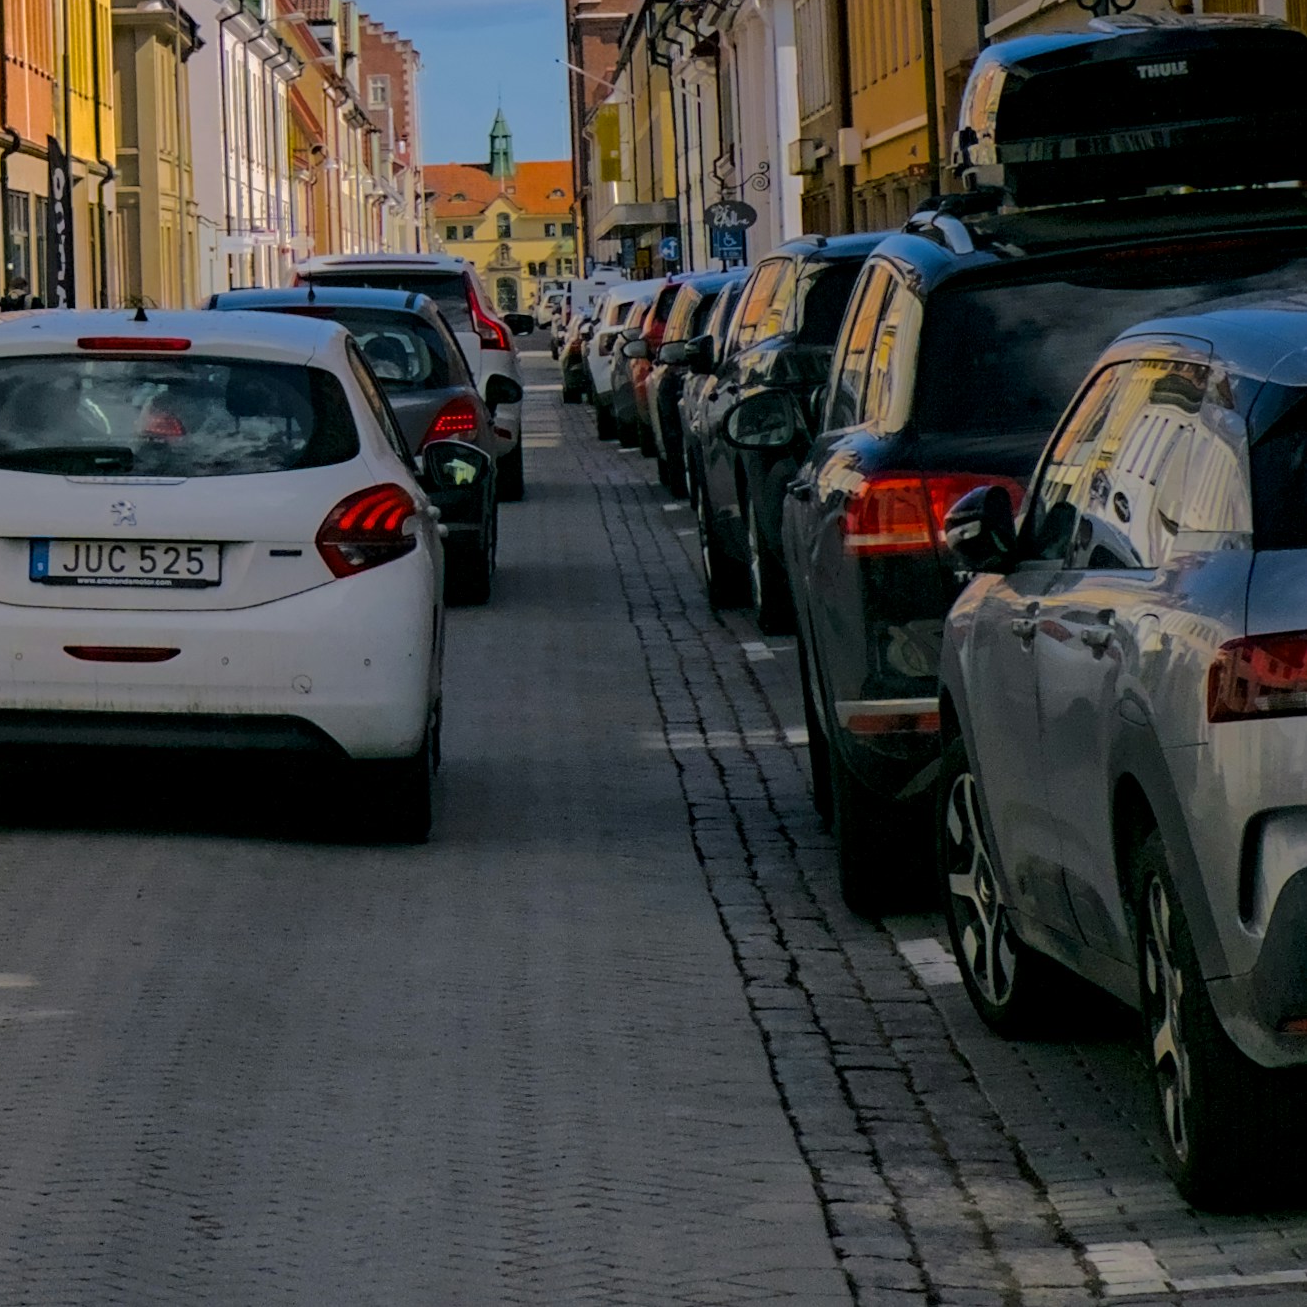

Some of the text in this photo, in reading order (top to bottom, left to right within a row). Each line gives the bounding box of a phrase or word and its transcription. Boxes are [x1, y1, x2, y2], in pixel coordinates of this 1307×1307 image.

[1136, 61, 1189, 79] THULE
[63, 544, 126, 574] JUC
[138, 545, 205, 575] 525
